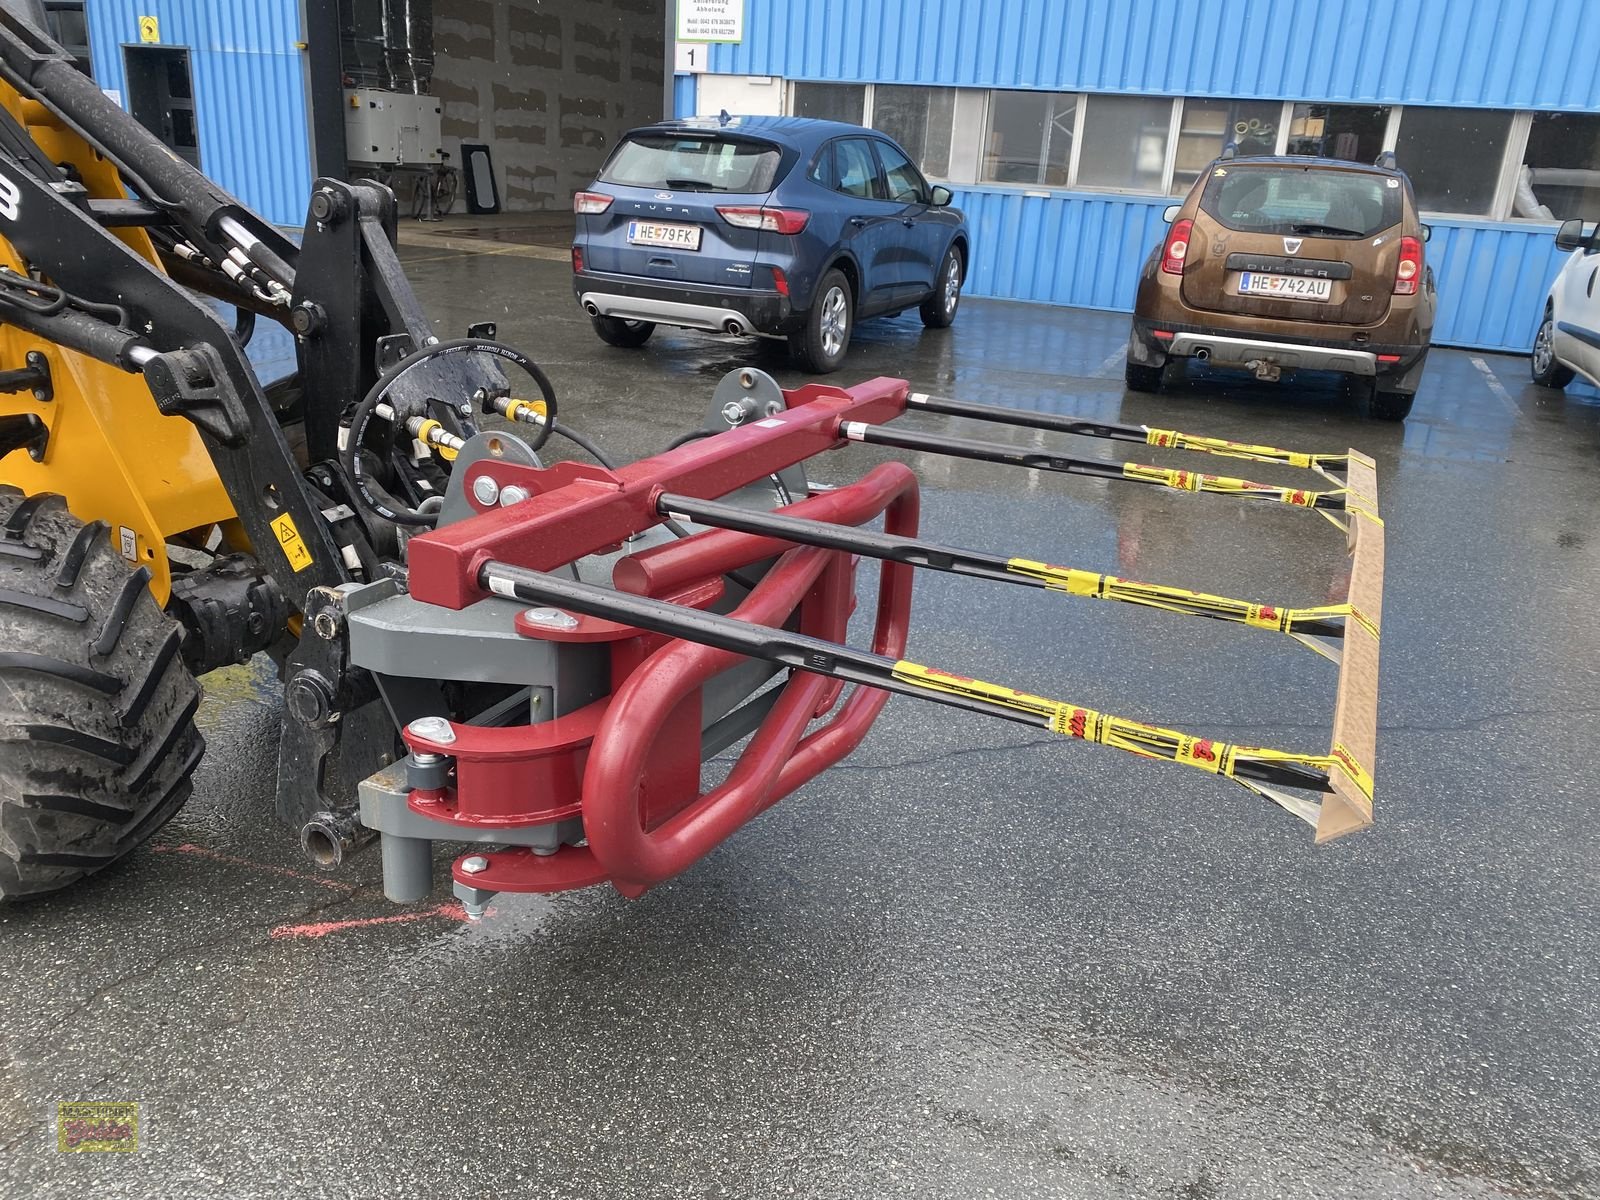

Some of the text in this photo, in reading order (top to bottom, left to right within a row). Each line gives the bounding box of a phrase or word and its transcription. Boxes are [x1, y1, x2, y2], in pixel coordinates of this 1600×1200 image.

[688, 49, 694, 66] 1
[1247, 264, 1328, 278] DUSTER
[1251, 275, 1270, 289] HE
